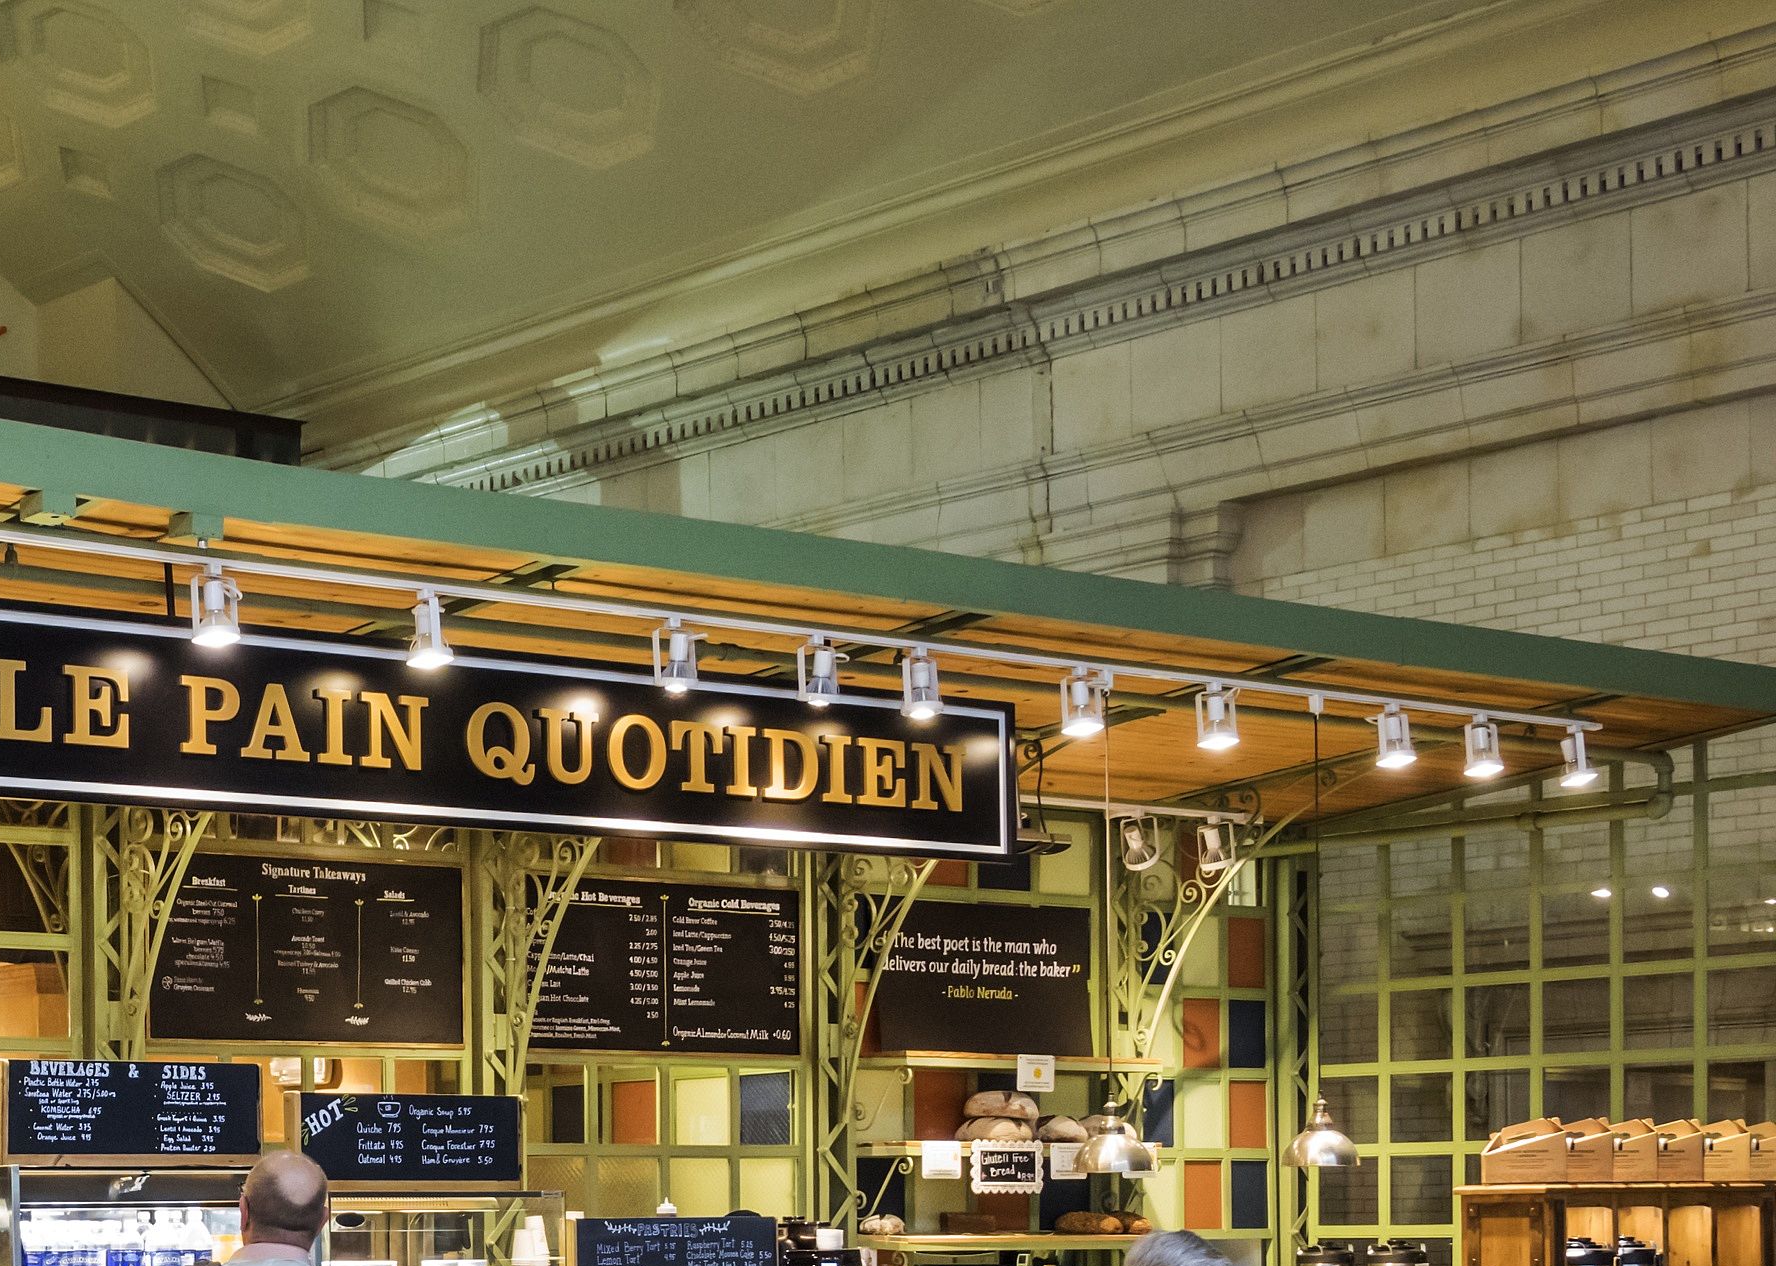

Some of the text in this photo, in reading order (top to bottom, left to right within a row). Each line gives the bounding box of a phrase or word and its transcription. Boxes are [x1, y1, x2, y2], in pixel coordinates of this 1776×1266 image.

[178, 674, 429, 771] PAIN
[466, 701, 968, 815] QUOTIDIEN
[261, 863, 366, 885] Signature Takeaways
[191, 876, 226, 887] Breakfast
[384, 890, 405, 899] Salads
[581, 891, 641, 906] Hot Beverages
[688, 897, 780, 912] Organic Cold Beverages
[917, 933, 941, 950] best
[943, 936, 969, 955] poet
[972, 936, 981, 951] is
[983, 937, 1002, 953] the
[1004, 942, 1031, 955] man
[1032, 939, 1057, 955] who
[928, 962, 949, 973] our
[951, 958, 981, 980] daily
[1019, 961, 1037, 976] the
[29, 1060, 207, 1080] BEVERAGES & SIDES
[47, 1077, 65, 1087] Bottle
[65, 1078, 83, 1087] Water
[160, 1080, 196, 1091] Apple Juice
[52, 1088, 73, 1098] Water
[166, 1091, 201, 1101] SELTZER
[40, 1105, 81, 1114] KOMBUCHA
[408, 1104, 434, 1120] Organic
[436, 1106, 455, 1119] Soup
[304, 1098, 345, 1137] HOT
[356, 1121, 383, 1134] Quiche
[422, 1123, 476, 1137] Croque Monsieur
[37, 1132, 58, 1142] Orange
[358, 1138, 386, 1150] Frittata
[421, 1139, 476, 1154] Croque Forestier
[357, 1153, 386, 1164] Oatmeal
[981, 1152, 1030, 1165] Gluten Free
[990, 1164, 1016, 1177] Bread
[637, 1223, 699, 1238] PASTRIES
[596, 1240, 661, 1255] Mixed Berry Tart
[686, 1237, 735, 1252] Raspberry Tart
[596, 1253, 640, 1266] Lemon Tart
[686, 1250, 716, 1260] Chocolate
[739, 1249, 755, 1259] Cake
